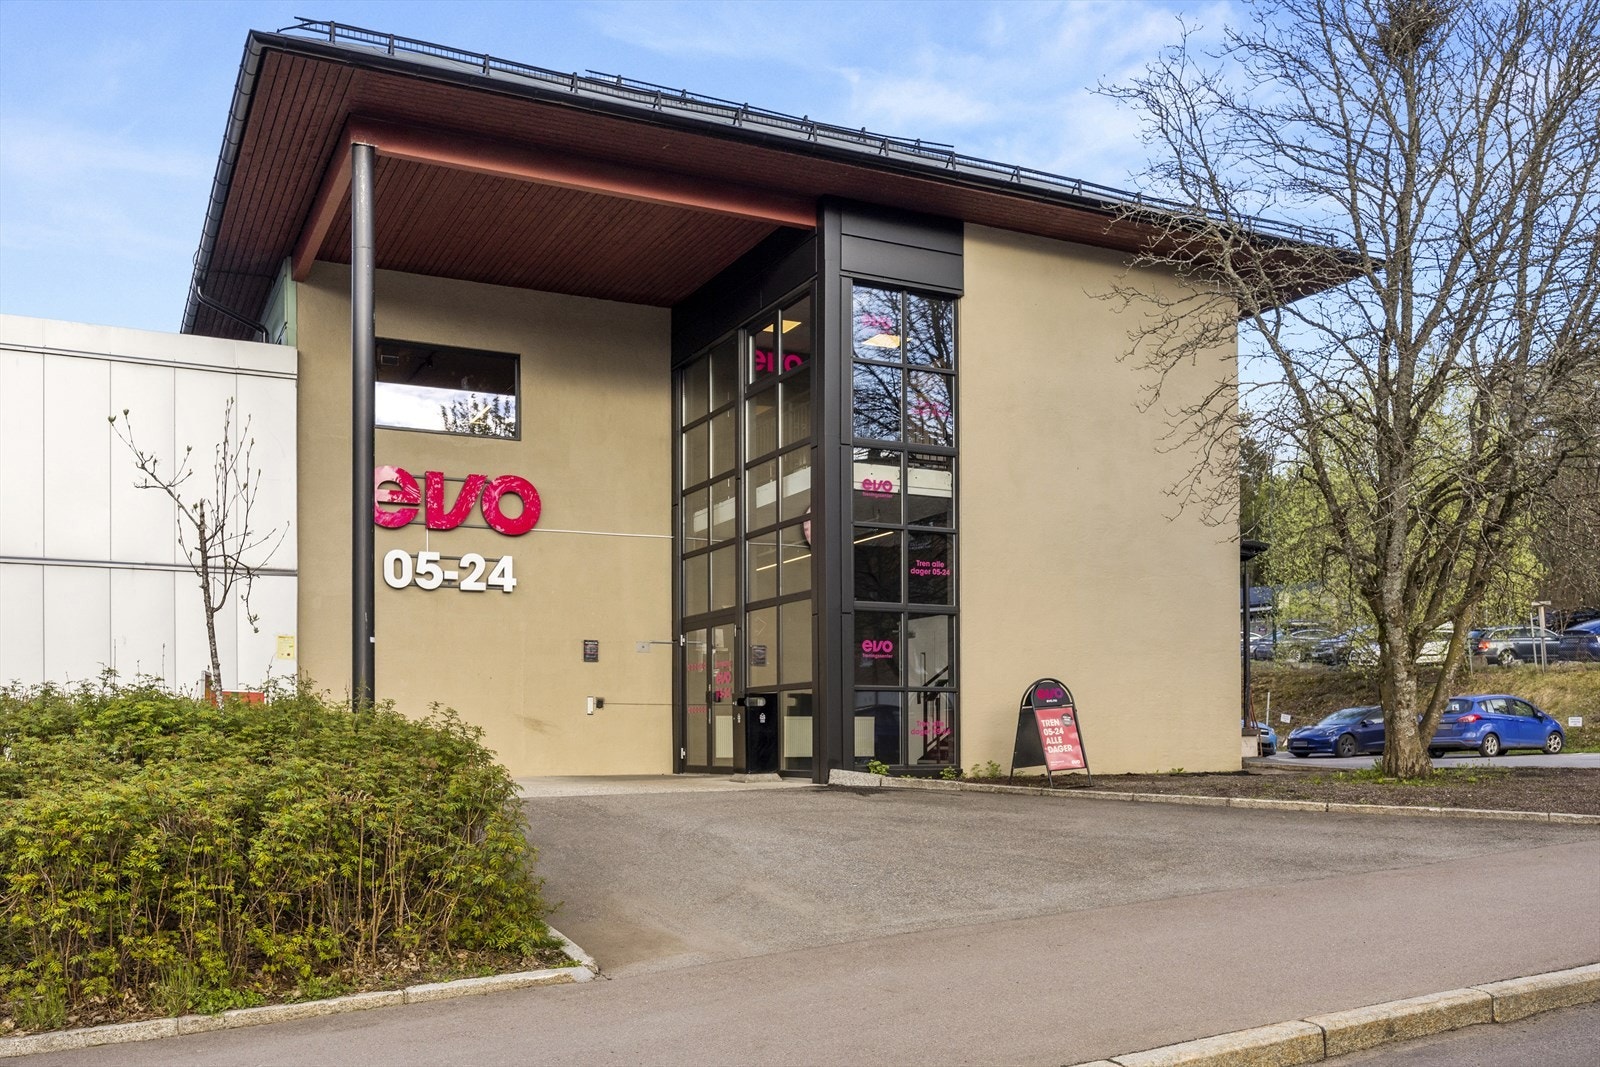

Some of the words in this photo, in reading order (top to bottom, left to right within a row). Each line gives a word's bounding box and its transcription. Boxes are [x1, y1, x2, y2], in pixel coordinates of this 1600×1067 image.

[862, 478, 893, 492] evo
[374, 465, 542, 537] evo
[383, 549, 517, 593] 05-24
[910, 568, 931, 576] dager
[862, 640, 893, 652] evo
[1041, 718, 1060, 727] TREN
[1043, 727, 1064, 736] 05-24
[1046, 736, 1063, 745] ALLE
[1047, 744, 1073, 754] DAGER
